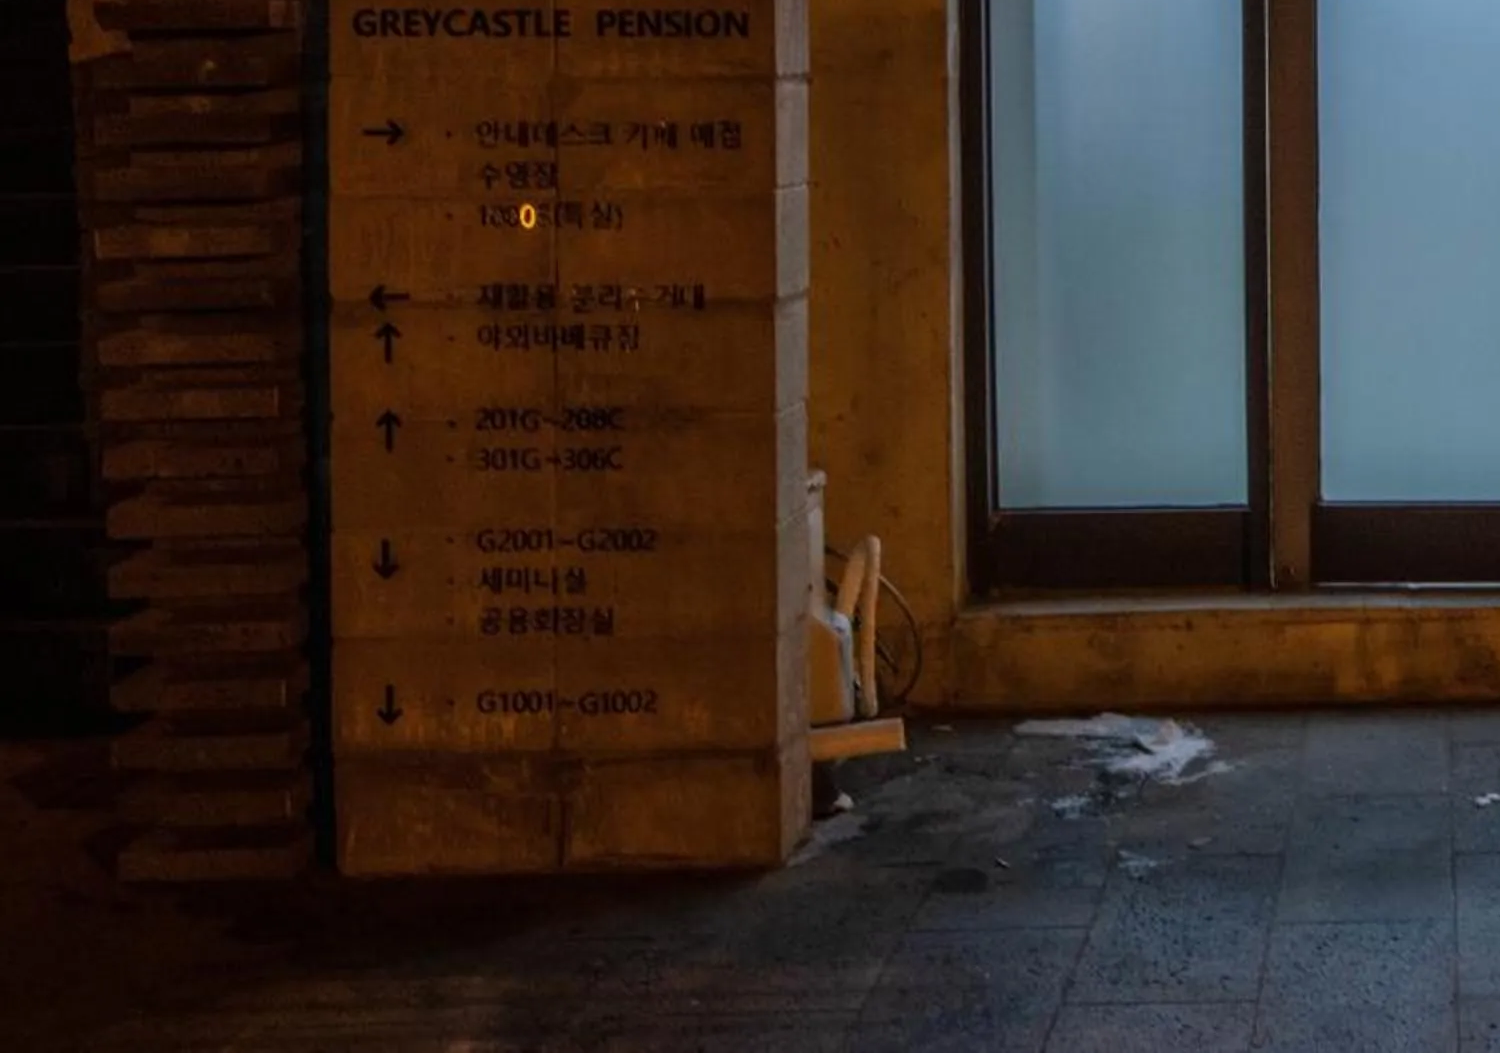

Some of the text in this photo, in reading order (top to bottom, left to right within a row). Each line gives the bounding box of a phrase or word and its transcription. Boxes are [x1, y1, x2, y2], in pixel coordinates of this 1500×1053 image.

[352, 8, 750, 39] GREYCASTLE PENSION
[476, 120, 611, 149] 안내데스크
[690, 120, 742, 149] 매점
